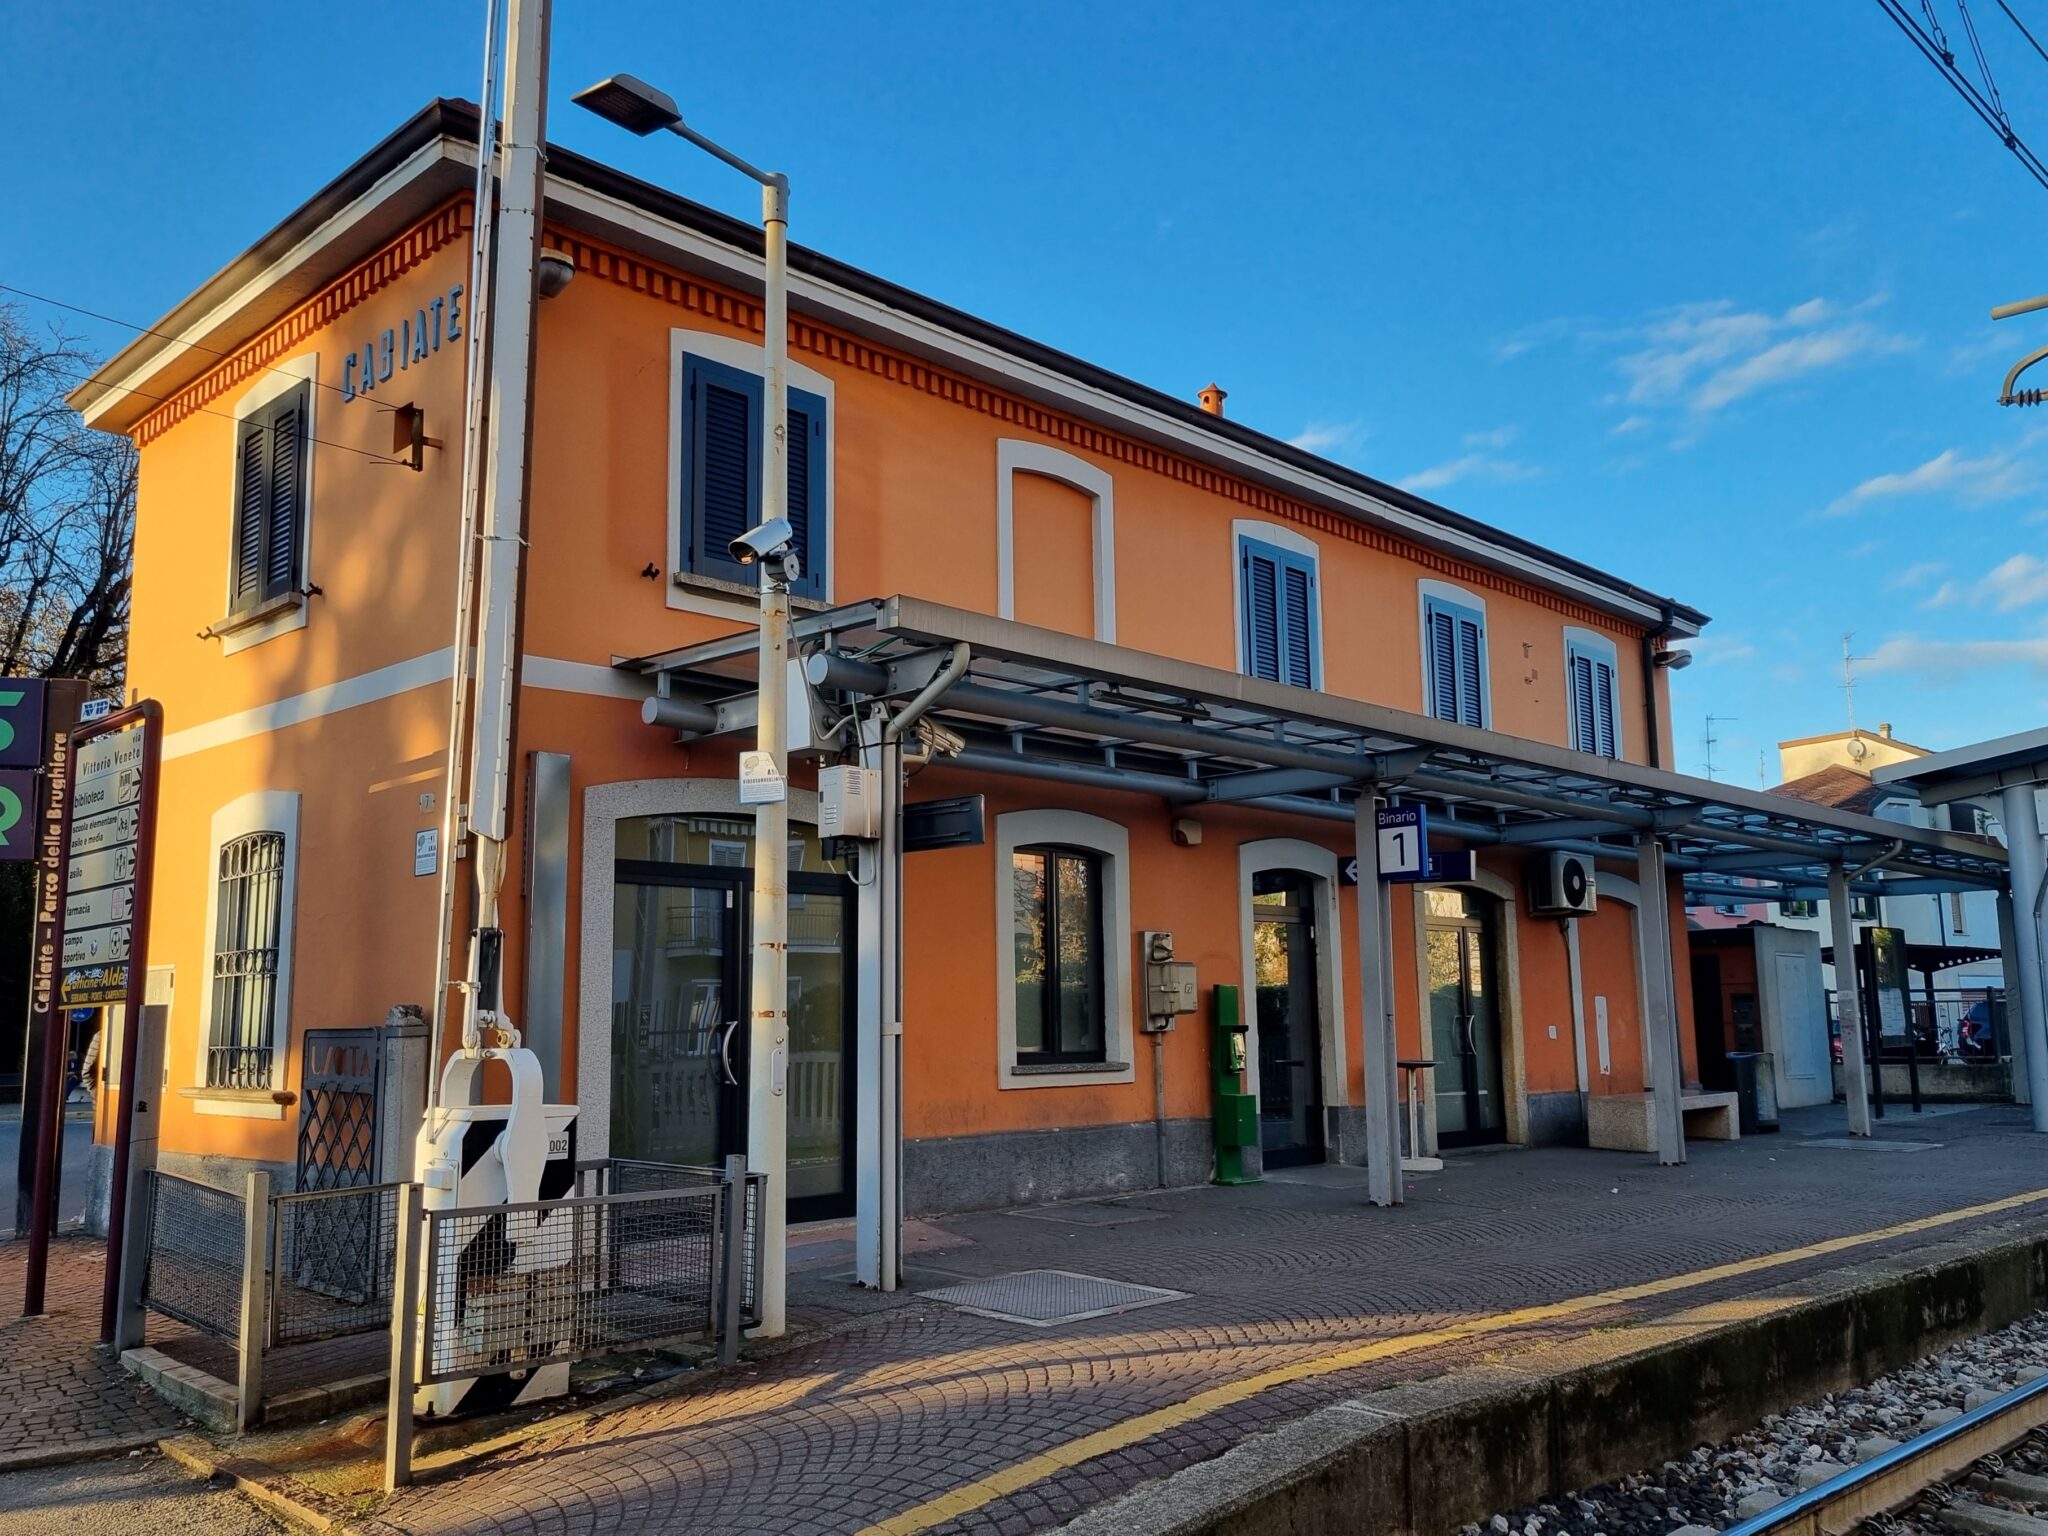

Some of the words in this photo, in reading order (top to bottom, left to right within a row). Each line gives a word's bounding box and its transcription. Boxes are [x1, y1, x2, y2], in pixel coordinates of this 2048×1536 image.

[343, 284, 464, 404] CABIATE
[132, 733, 142, 744] via
[82, 755, 111, 777] Vittorio
[114, 748, 141, 766] Veneto
[46, 732, 68, 819] Brughiera
[74, 789, 105, 809] biblioteca
[72, 821, 89, 834] scuola
[89, 815, 118, 829] elementare
[1378, 810, 1417, 825] Binario
[43, 823, 62, 869] della
[71, 836, 83, 849] asilo
[88, 832, 104, 844] media
[1392, 832, 1405, 867] 1
[69, 867, 83, 880] asilo
[39, 872, 59, 922] Parco
[66, 902, 91, 917] farmacia
[64, 935, 83, 948] campo
[63, 950, 86, 964] sportivo
[33, 943, 54, 1014] Cabiate
[102, 966, 124, 987] Alde
